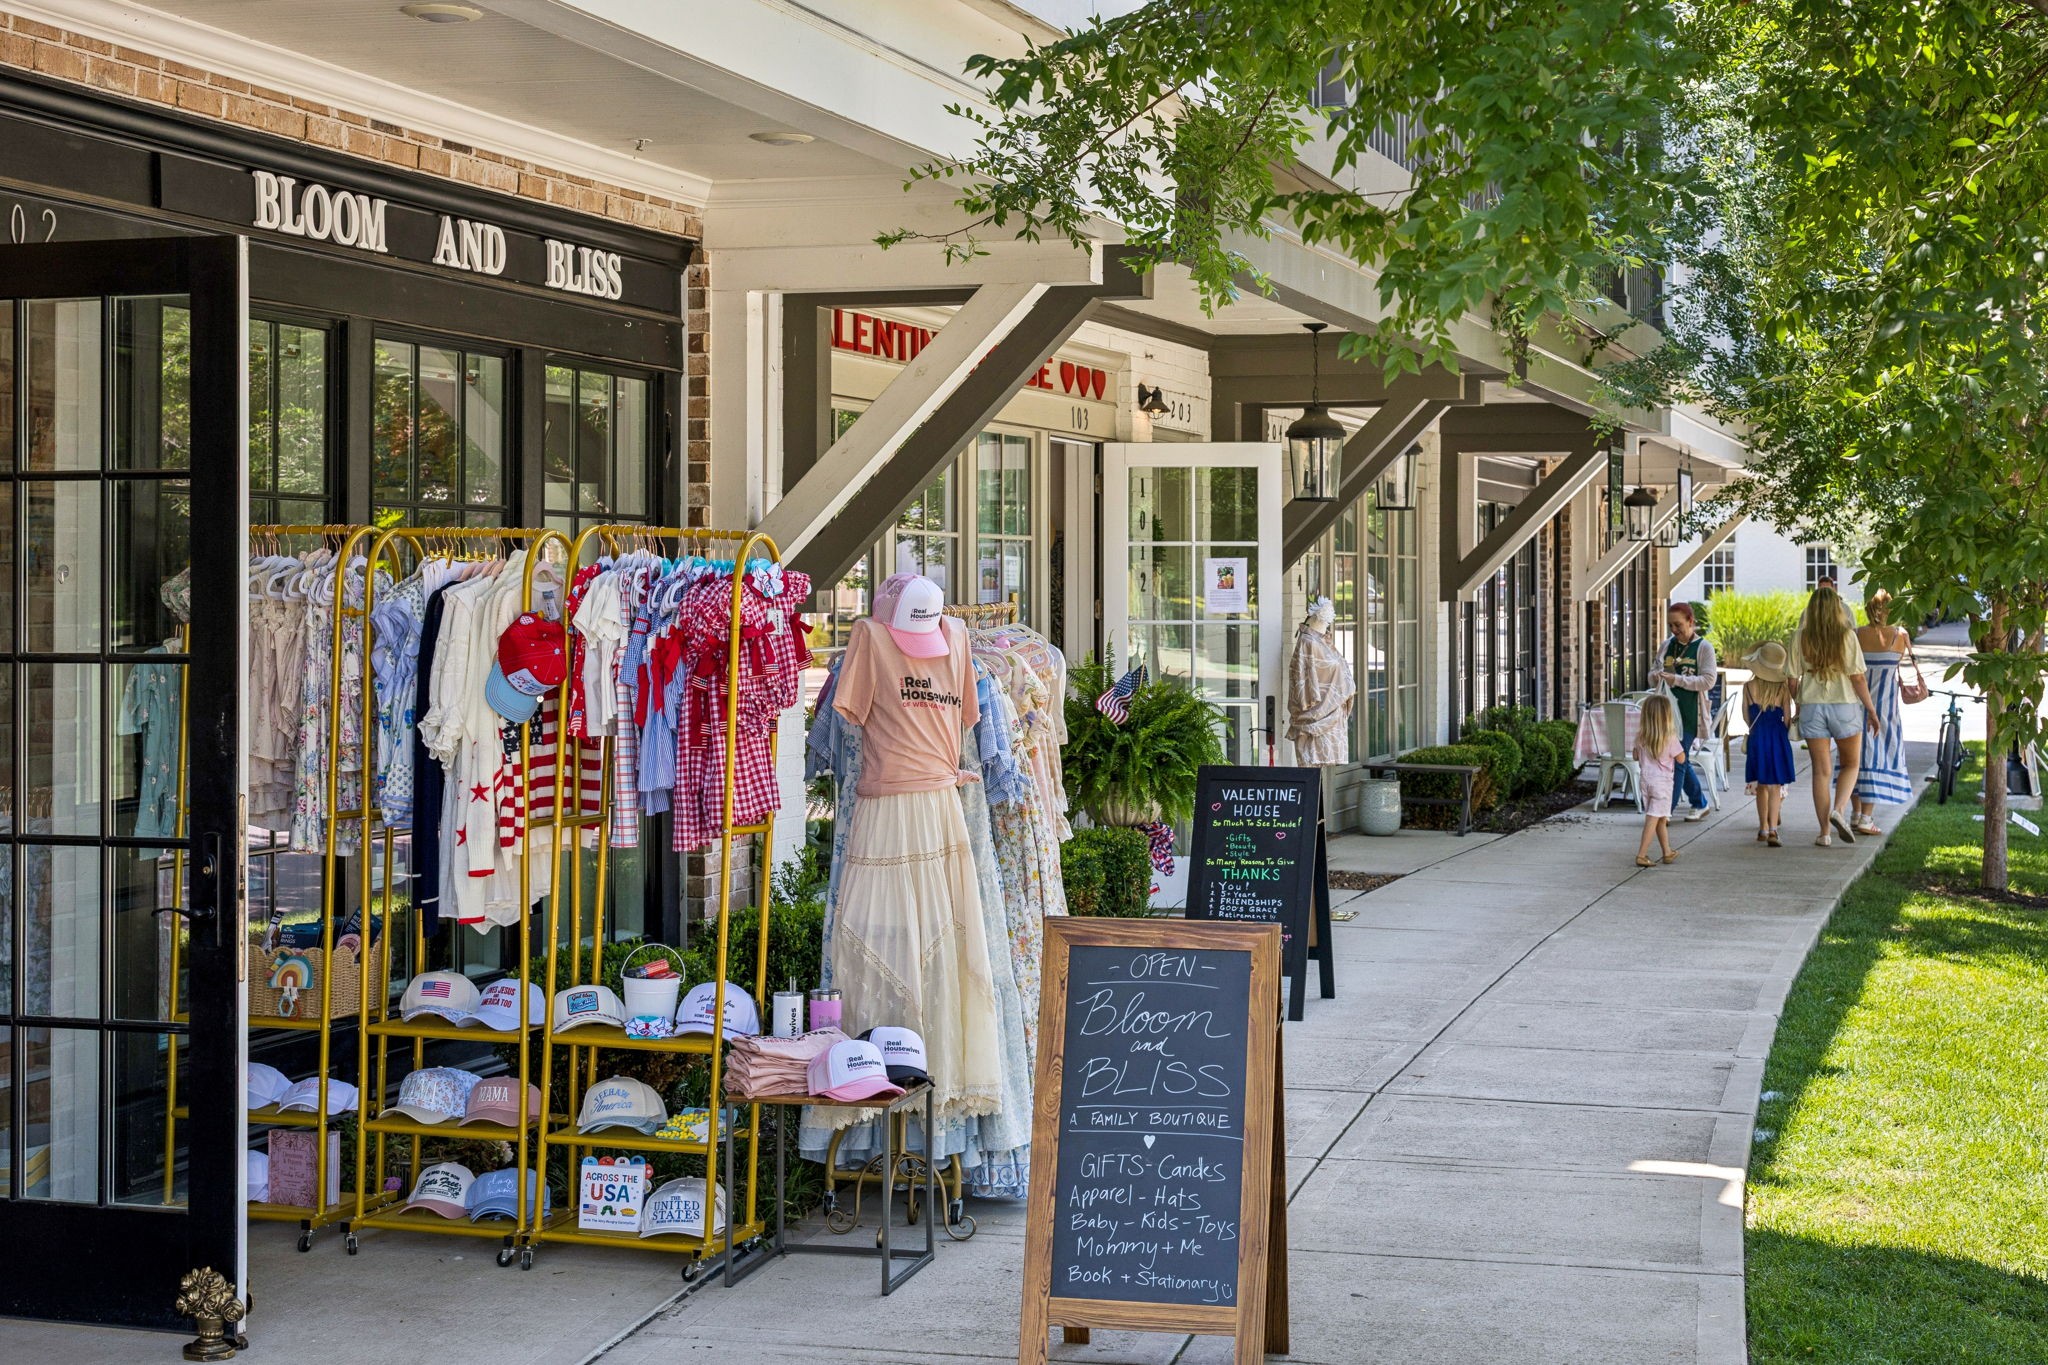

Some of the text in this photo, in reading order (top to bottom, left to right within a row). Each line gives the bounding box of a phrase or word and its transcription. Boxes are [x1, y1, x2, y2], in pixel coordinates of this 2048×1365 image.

[252, 170, 622, 300] BLOOM AND BLISS
[1170, 400, 1191, 423] 203
[1071, 406, 1089, 431] 103
[1681, 666, 1695, 676] 25
[904, 676, 931, 688] Real
[1222, 788, 1298, 801] VALENTINE
[1233, 804, 1280, 817] HOUSE
[1223, 818, 1244, 827] Much
[1247, 819, 1254, 827] To
[1256, 819, 1270, 827] See
[1229, 833, 1251, 841] Gifts
[1229, 843, 1256, 852] Beauty
[1229, 851, 1249, 860] Style
[1216, 858, 1236, 868] Many
[1240, 858, 1265, 866] Reasons
[1222, 868, 1280, 881] THANKS
[1220, 898, 1283, 907] FRIENDSHIPS
[1218, 911, 1267, 920] Retirement
[1249, 906, 1278, 914] GRACE
[1130, 953, 1196, 978] OPEN
[501, 999, 512, 1008] TOO
[1076, 989, 1231, 1038] Bloom
[884, 1046, 920, 1054] Housewives
[1130, 1037, 1175, 1056] and
[847, 1059, 881, 1068] Housewives
[849, 1054, 863, 1062] Real
[1078, 1057, 1231, 1097] BLISS
[477, 1086, 509, 1102] MAMA
[594, 1088, 630, 1104] YEEHAW
[591, 1100, 633, 1113] America
[1069, 1111, 1231, 1129] A FAMILY BOUTIQUE
[586, 1172, 638, 1183] ACROSS THE
[590, 1183, 630, 1202] USA
[1069, 1184, 1202, 1210] Apparel Hats
[654, 1200, 700, 1211] UNITED
[652, 1210, 700, 1220] STATES
[1071, 1211, 1236, 1241] Baby Kids Toys
[1077, 1236, 1158, 1270] Mommy
[1180, 1238, 1204, 1256] Me
[1068, 1265, 1112, 1285] Book
[1134, 1270, 1219, 1302] Stationary
